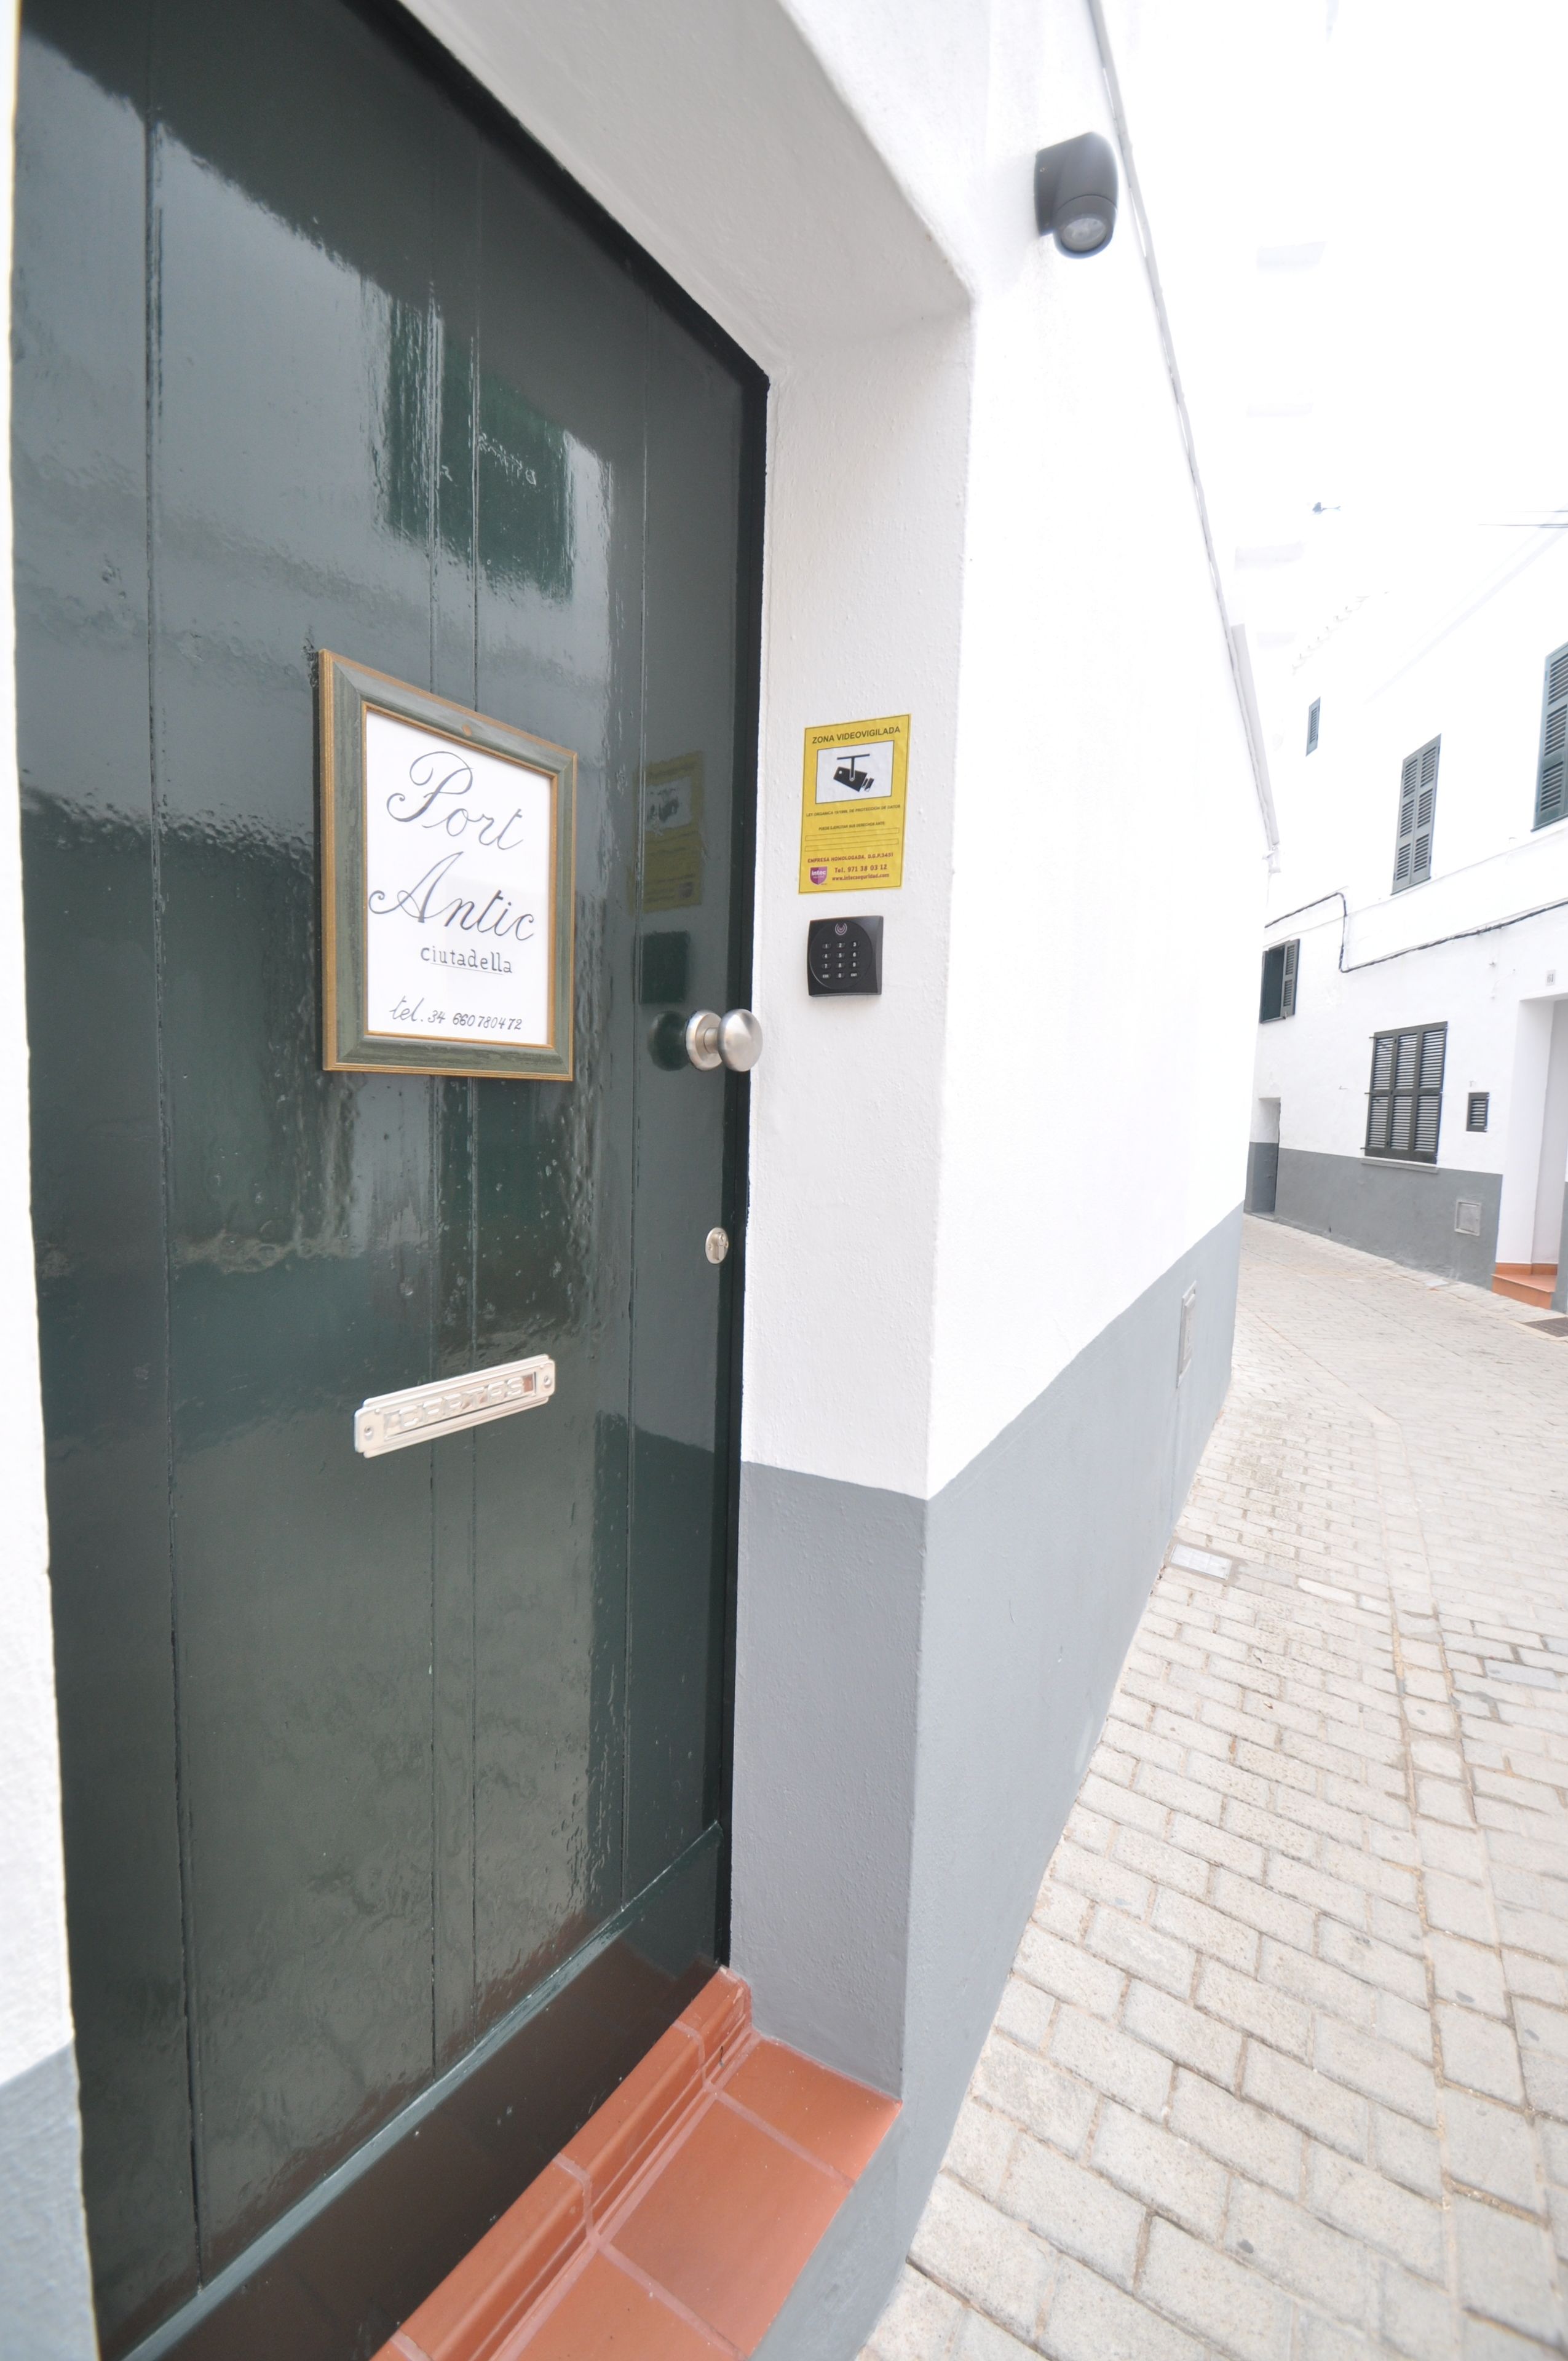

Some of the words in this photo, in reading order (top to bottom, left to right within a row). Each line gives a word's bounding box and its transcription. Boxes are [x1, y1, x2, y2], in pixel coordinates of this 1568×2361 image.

[812, 735, 834, 744] ZONA
[836, 726, 901, 741] VIDEOVIGILADA
[386, 751, 524, 850] Port
[368, 851, 534, 941] Antic
[420, 946, 512, 973] ciutadella
[389, 995, 423, 1022] tel.
[427, 1010, 446, 1024] 34
